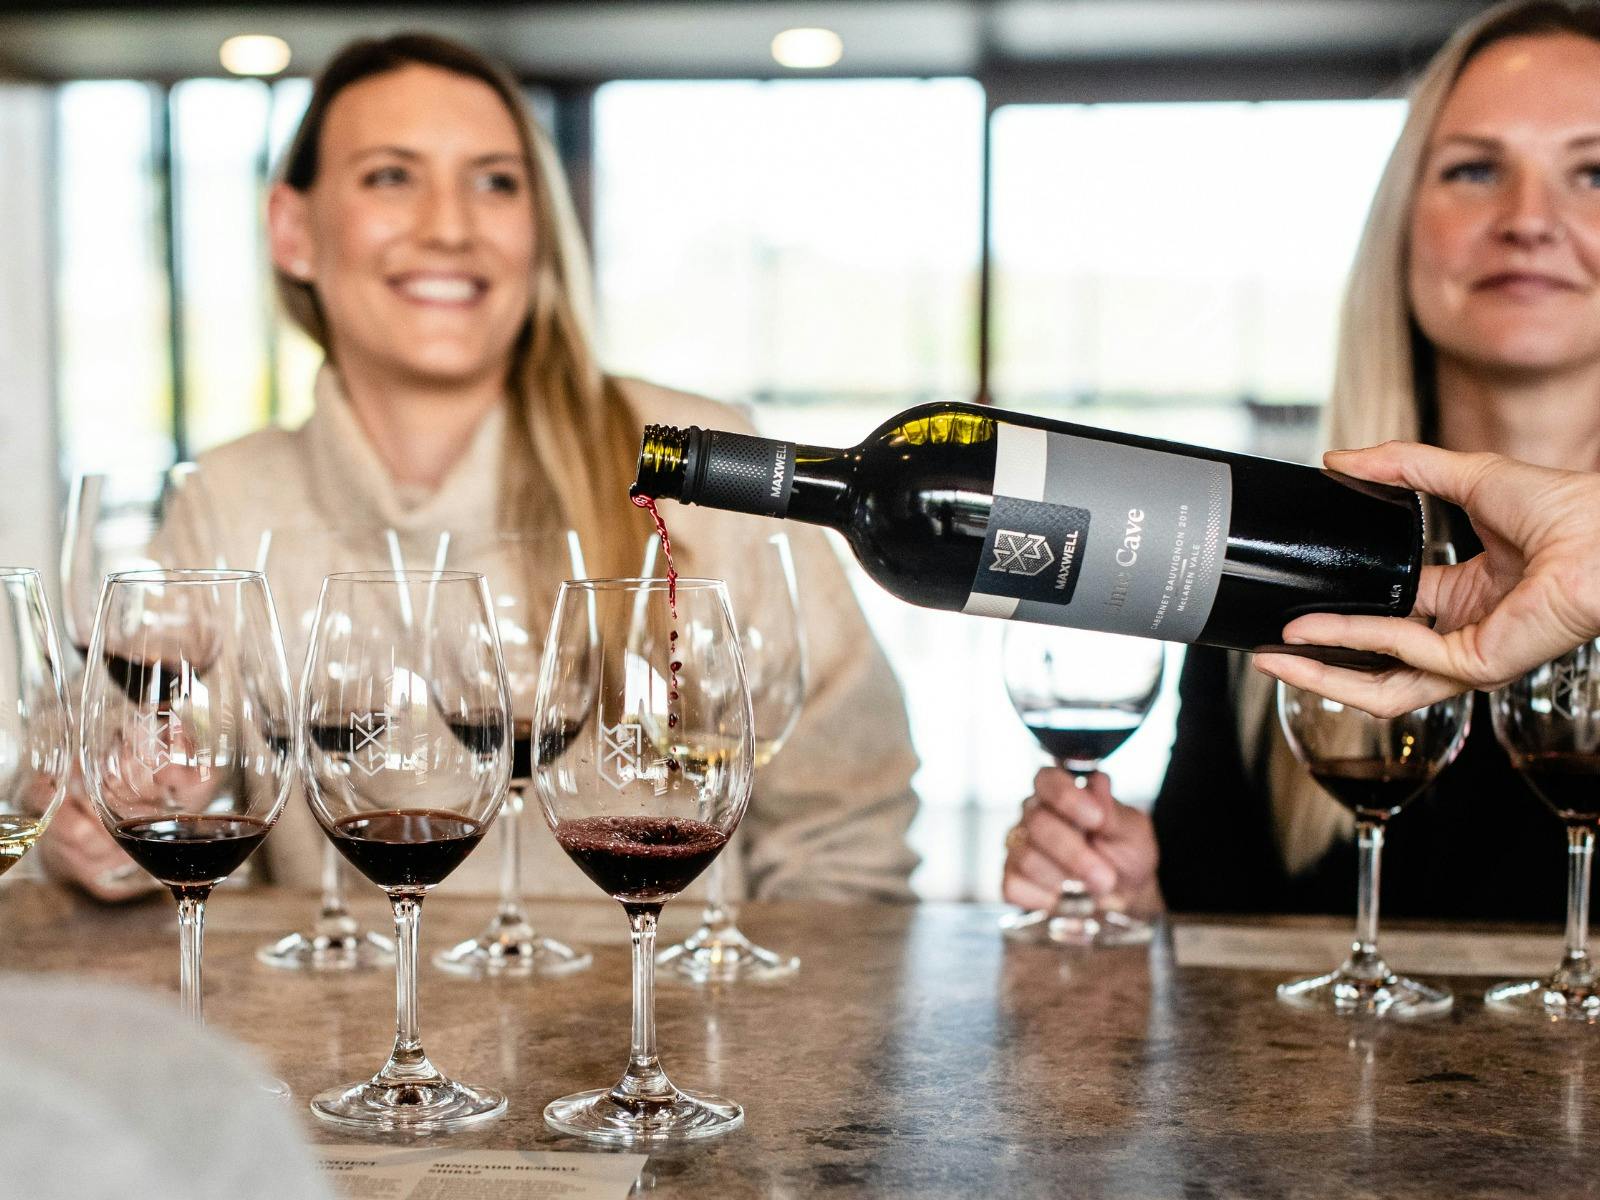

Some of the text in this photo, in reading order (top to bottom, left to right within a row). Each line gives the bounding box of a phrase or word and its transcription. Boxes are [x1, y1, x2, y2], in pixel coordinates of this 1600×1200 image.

[770, 444, 787, 498] MAXWELL
[1054, 530, 1079, 590] MAXWELL
[1116, 508, 1145, 567] Cave
[1150, 594, 1171, 630] CABERNET
[1164, 531, 1185, 591] SAUVIGNON
[1176, 544, 1200, 612] McLAREN VALE
